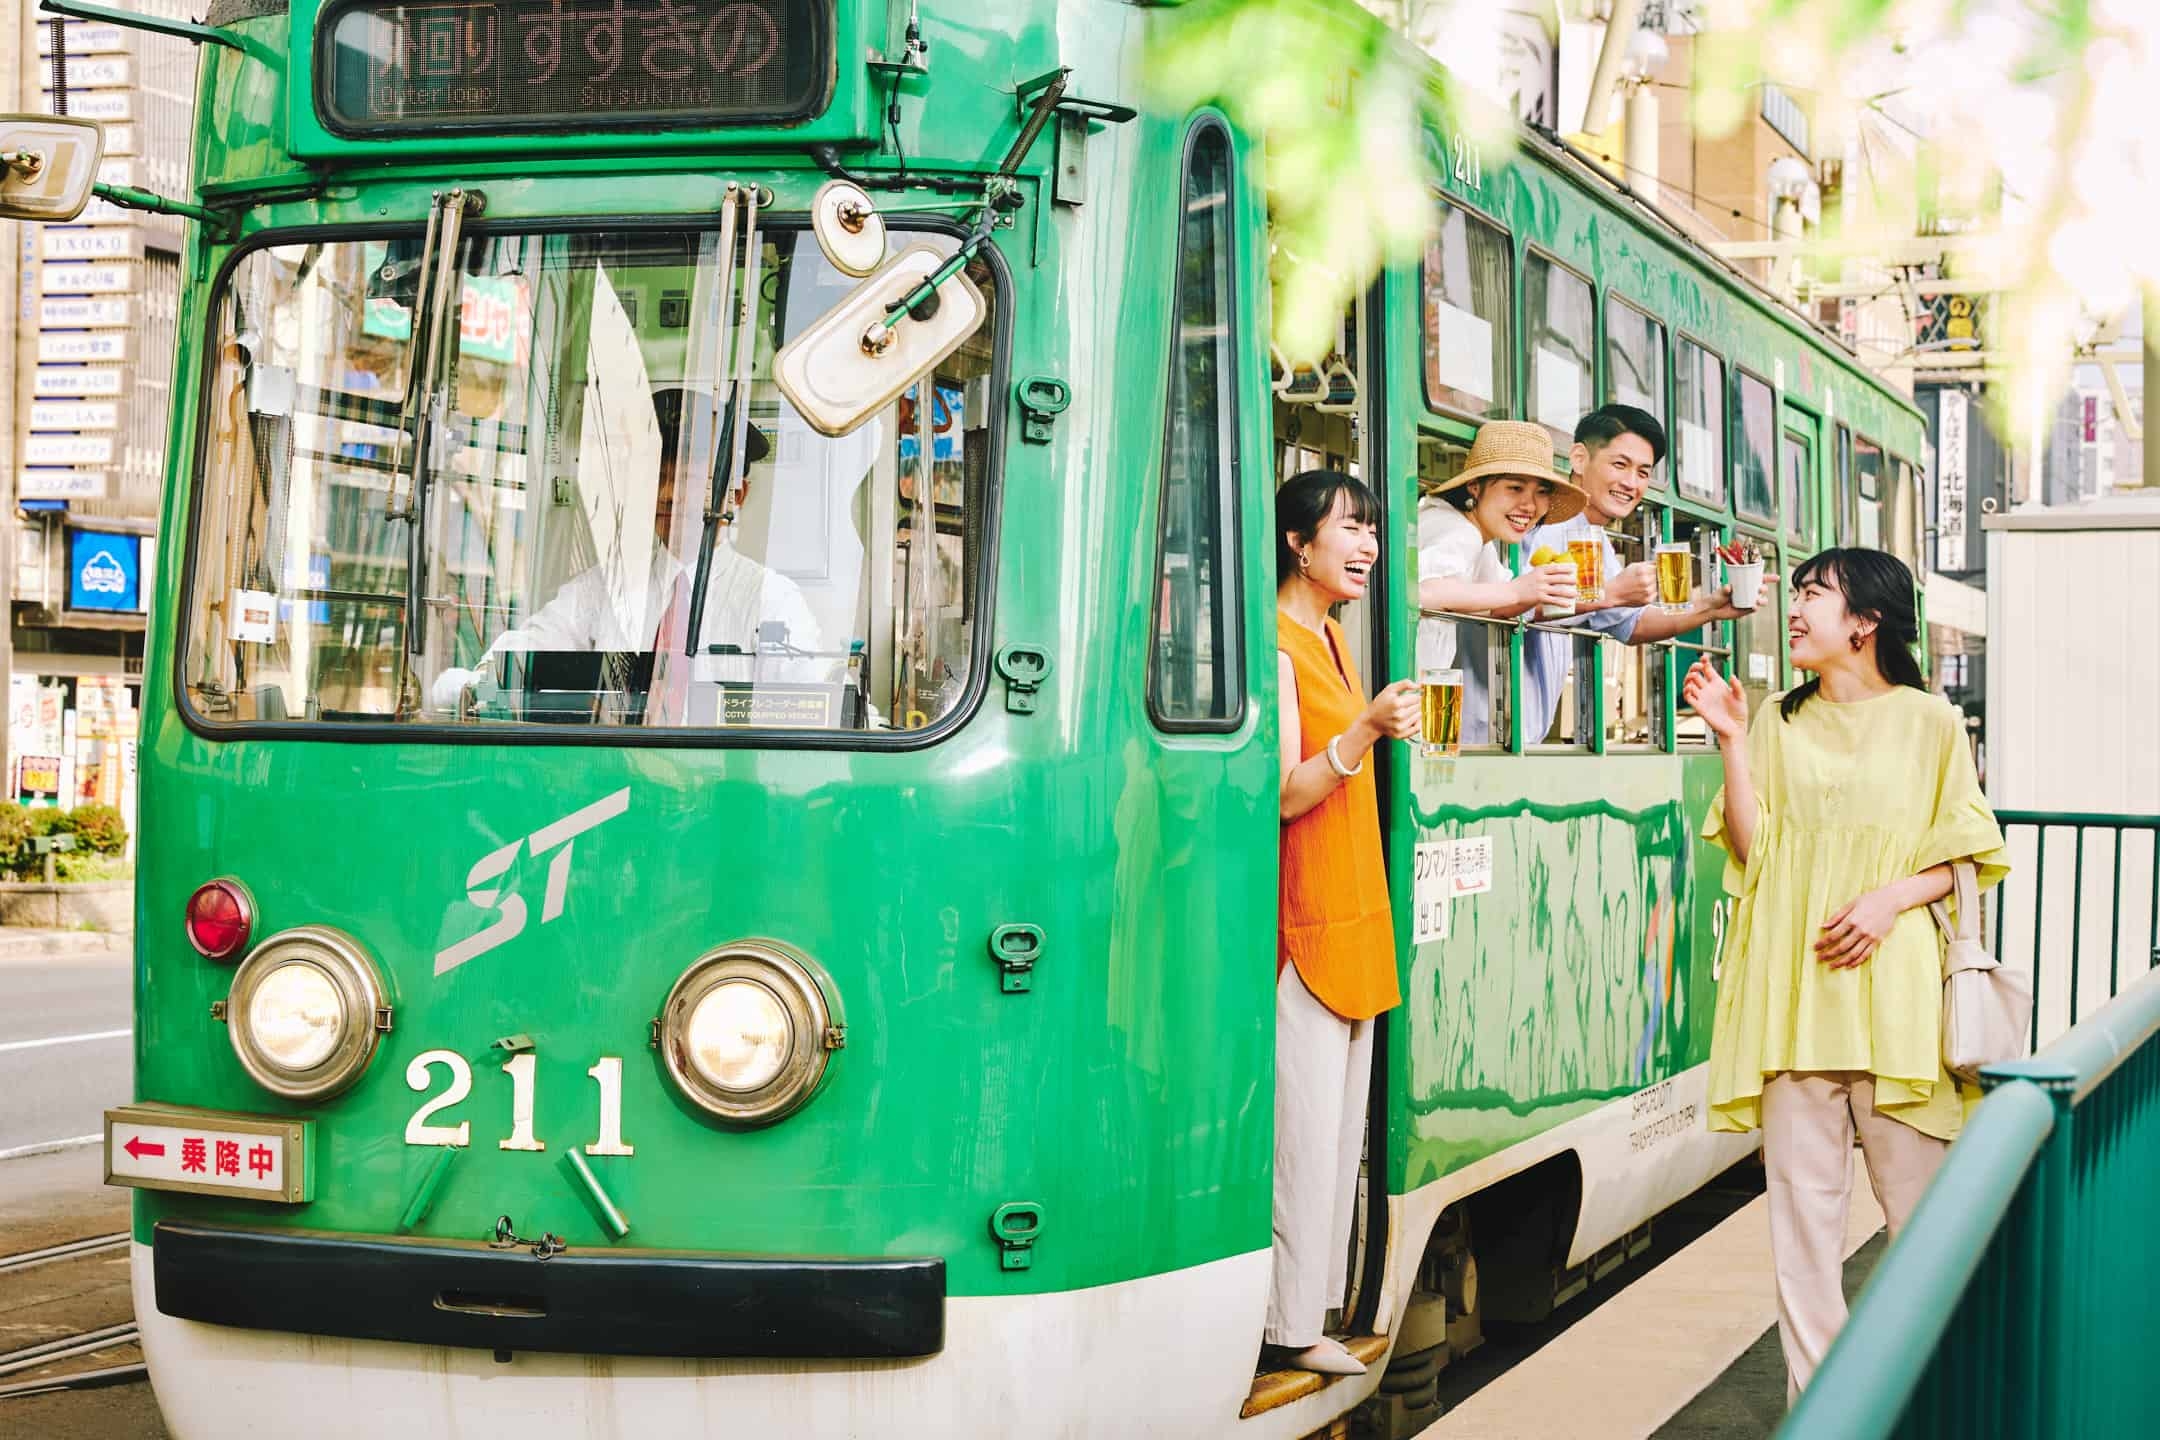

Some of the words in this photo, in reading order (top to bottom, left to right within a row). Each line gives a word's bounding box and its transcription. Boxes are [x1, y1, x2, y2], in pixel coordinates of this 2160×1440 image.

[518, 0, 779, 84] すすきの
[1453, 133, 1481, 191] 211
[405, 1048, 635, 1157] 211
[180, 1137, 273, 1181] 乗降中
